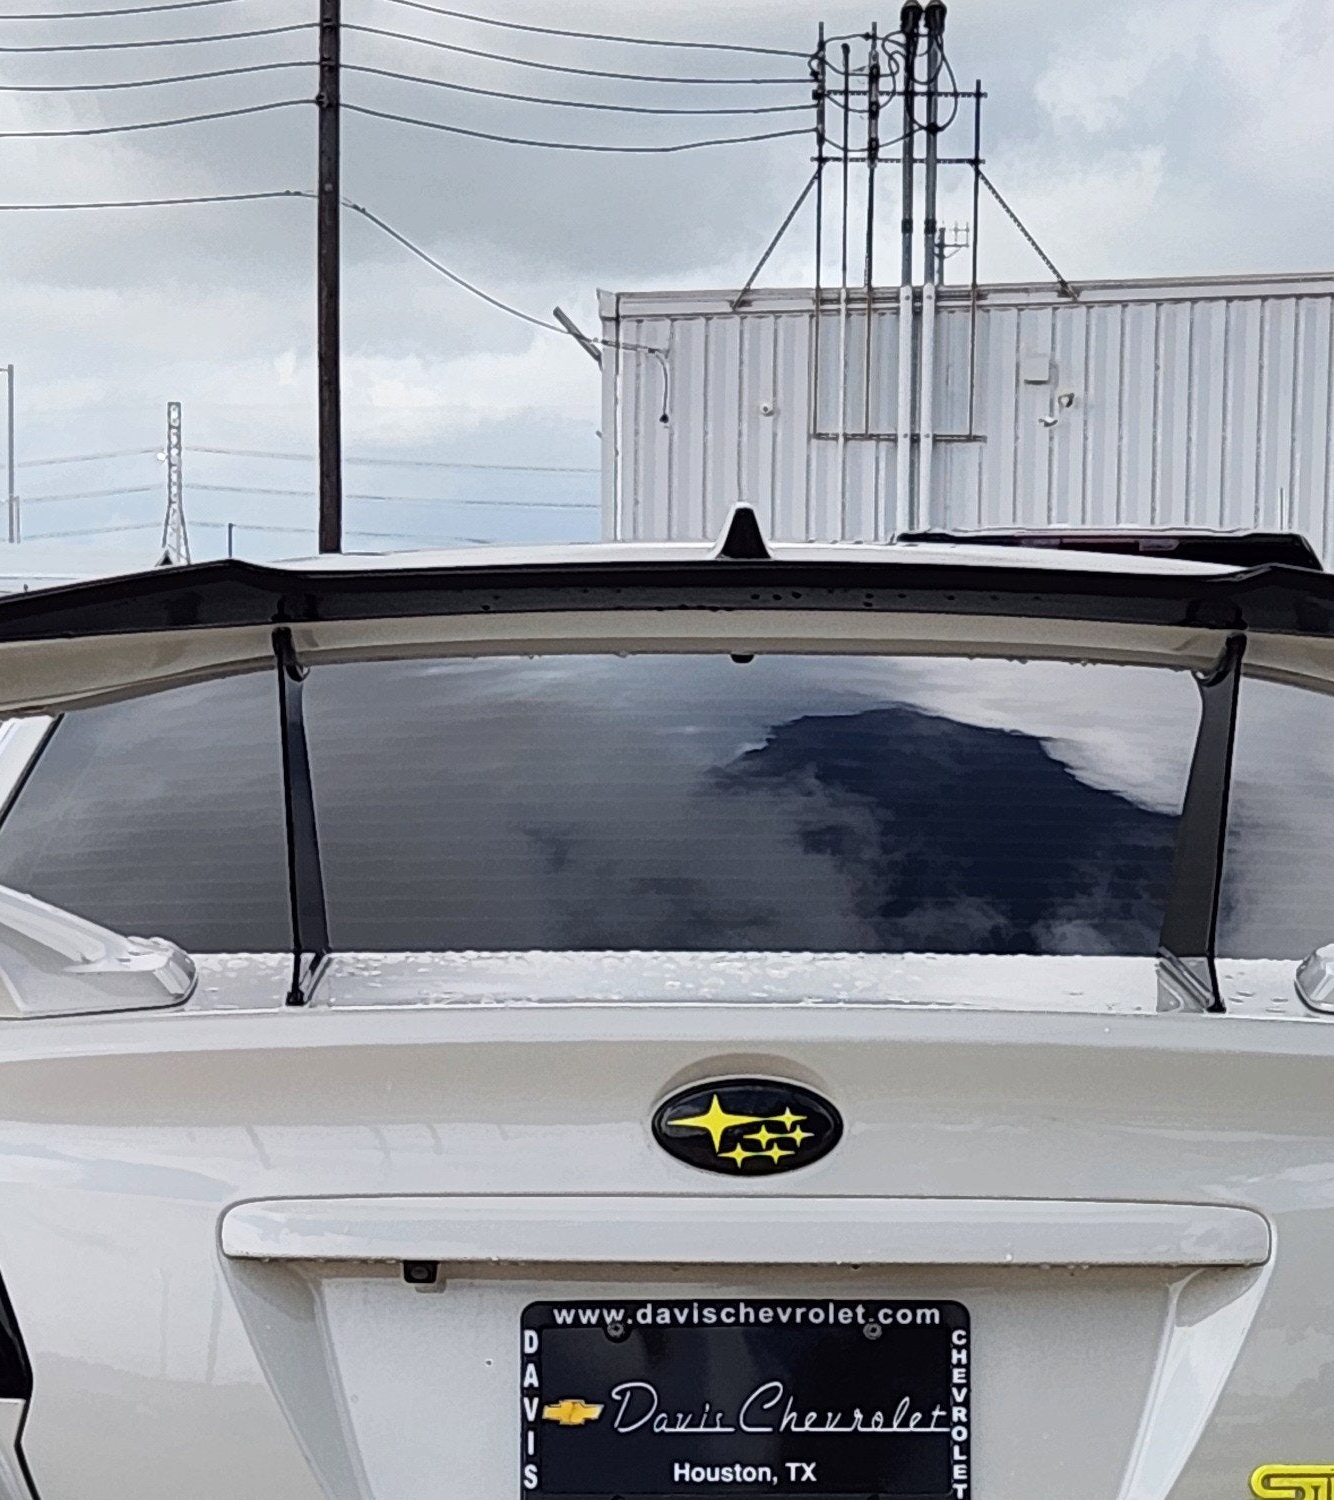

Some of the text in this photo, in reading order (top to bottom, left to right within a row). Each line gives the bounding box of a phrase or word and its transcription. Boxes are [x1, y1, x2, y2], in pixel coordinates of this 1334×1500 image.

[552, 1302, 941, 1325] www.davischevrolet.com
[523, 1329, 540, 1490] DAVIS
[611, 1380, 951, 1434] Davis Chevrolet
[951, 1329, 968, 1500] CHEVROLET
[672, 1462, 817, 1486] Houston, TX
